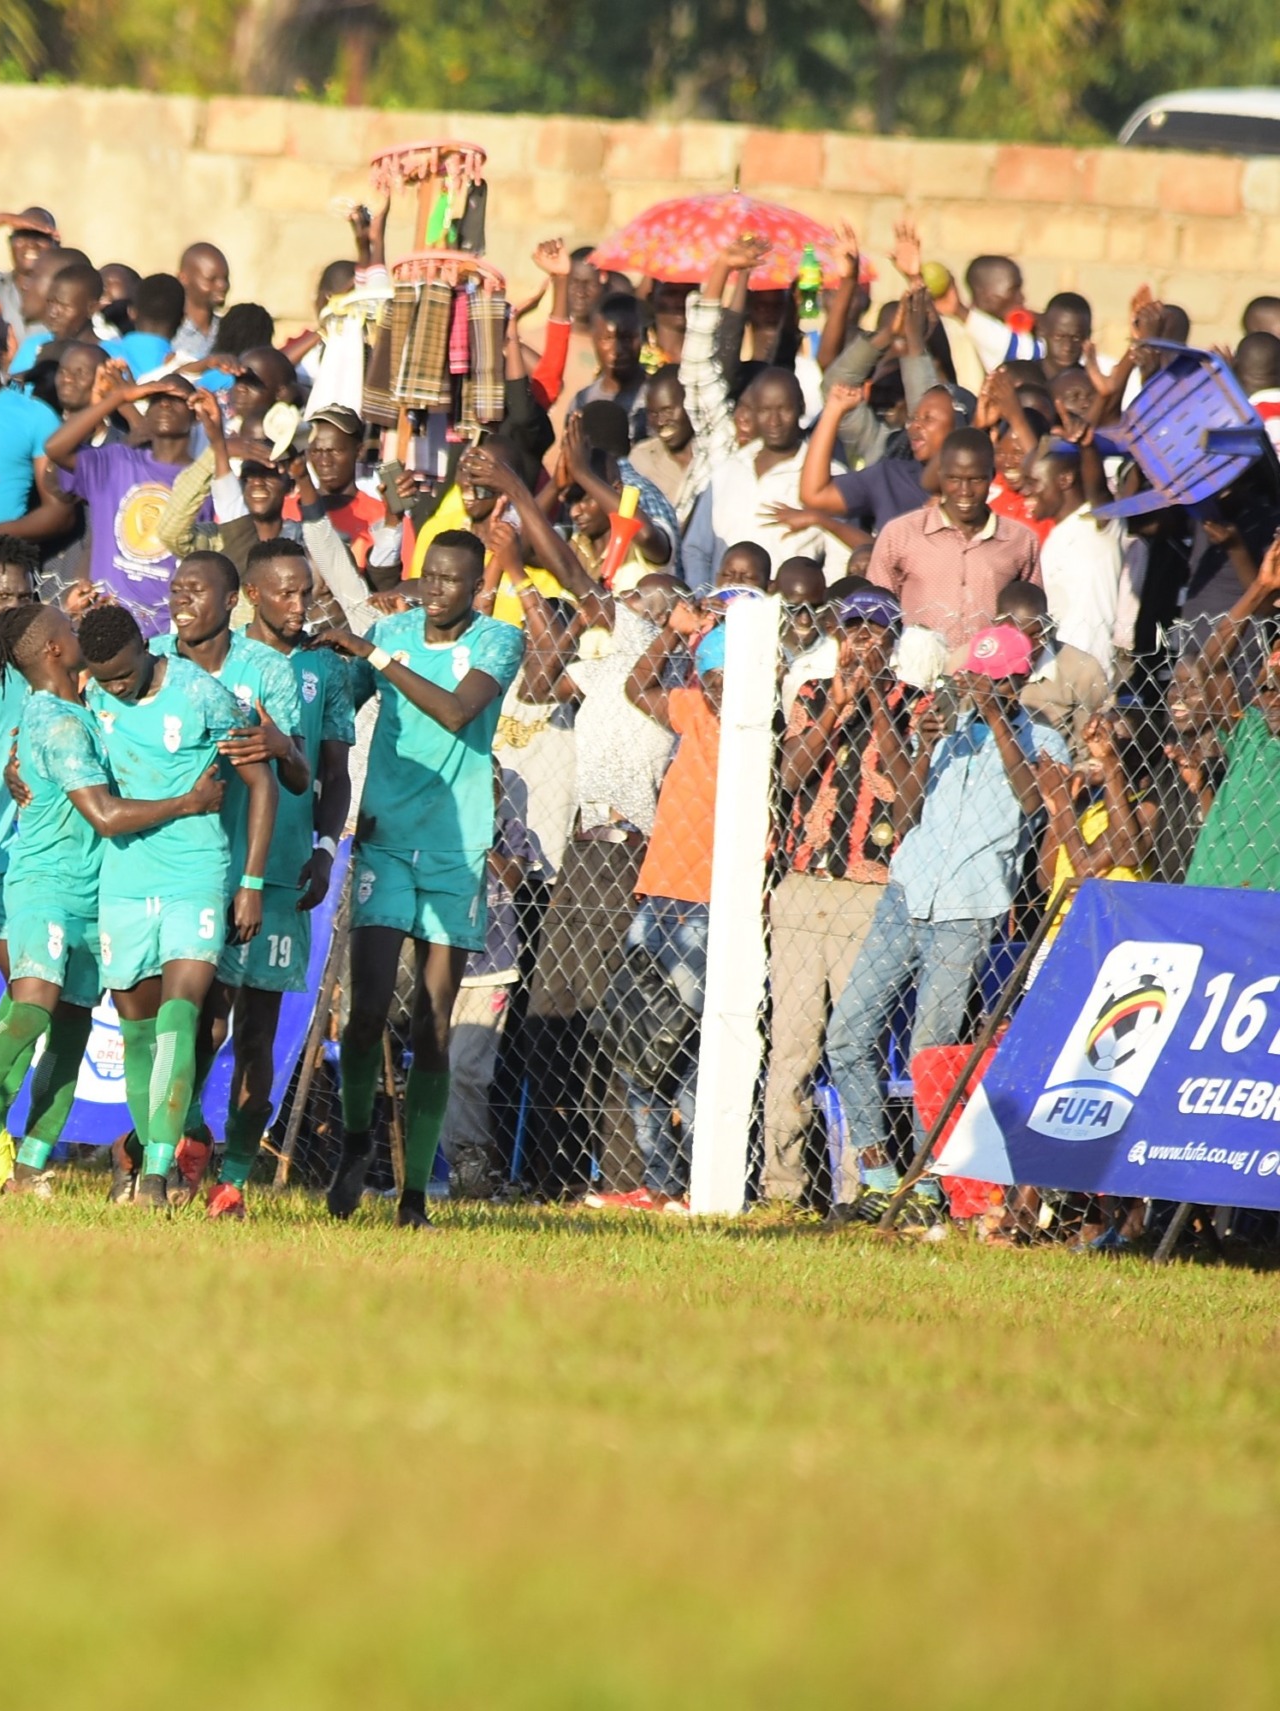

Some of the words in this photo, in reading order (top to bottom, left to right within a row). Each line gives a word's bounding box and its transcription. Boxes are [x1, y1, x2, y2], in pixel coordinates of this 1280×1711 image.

[198, 908, 216, 940] 5
[267, 934, 292, 968] 19
[1189, 972, 1280, 1054] 16
[1046, 1096, 1114, 1128] FUFA
[1147, 1142, 1248, 1171] www.fufa.co.ug
